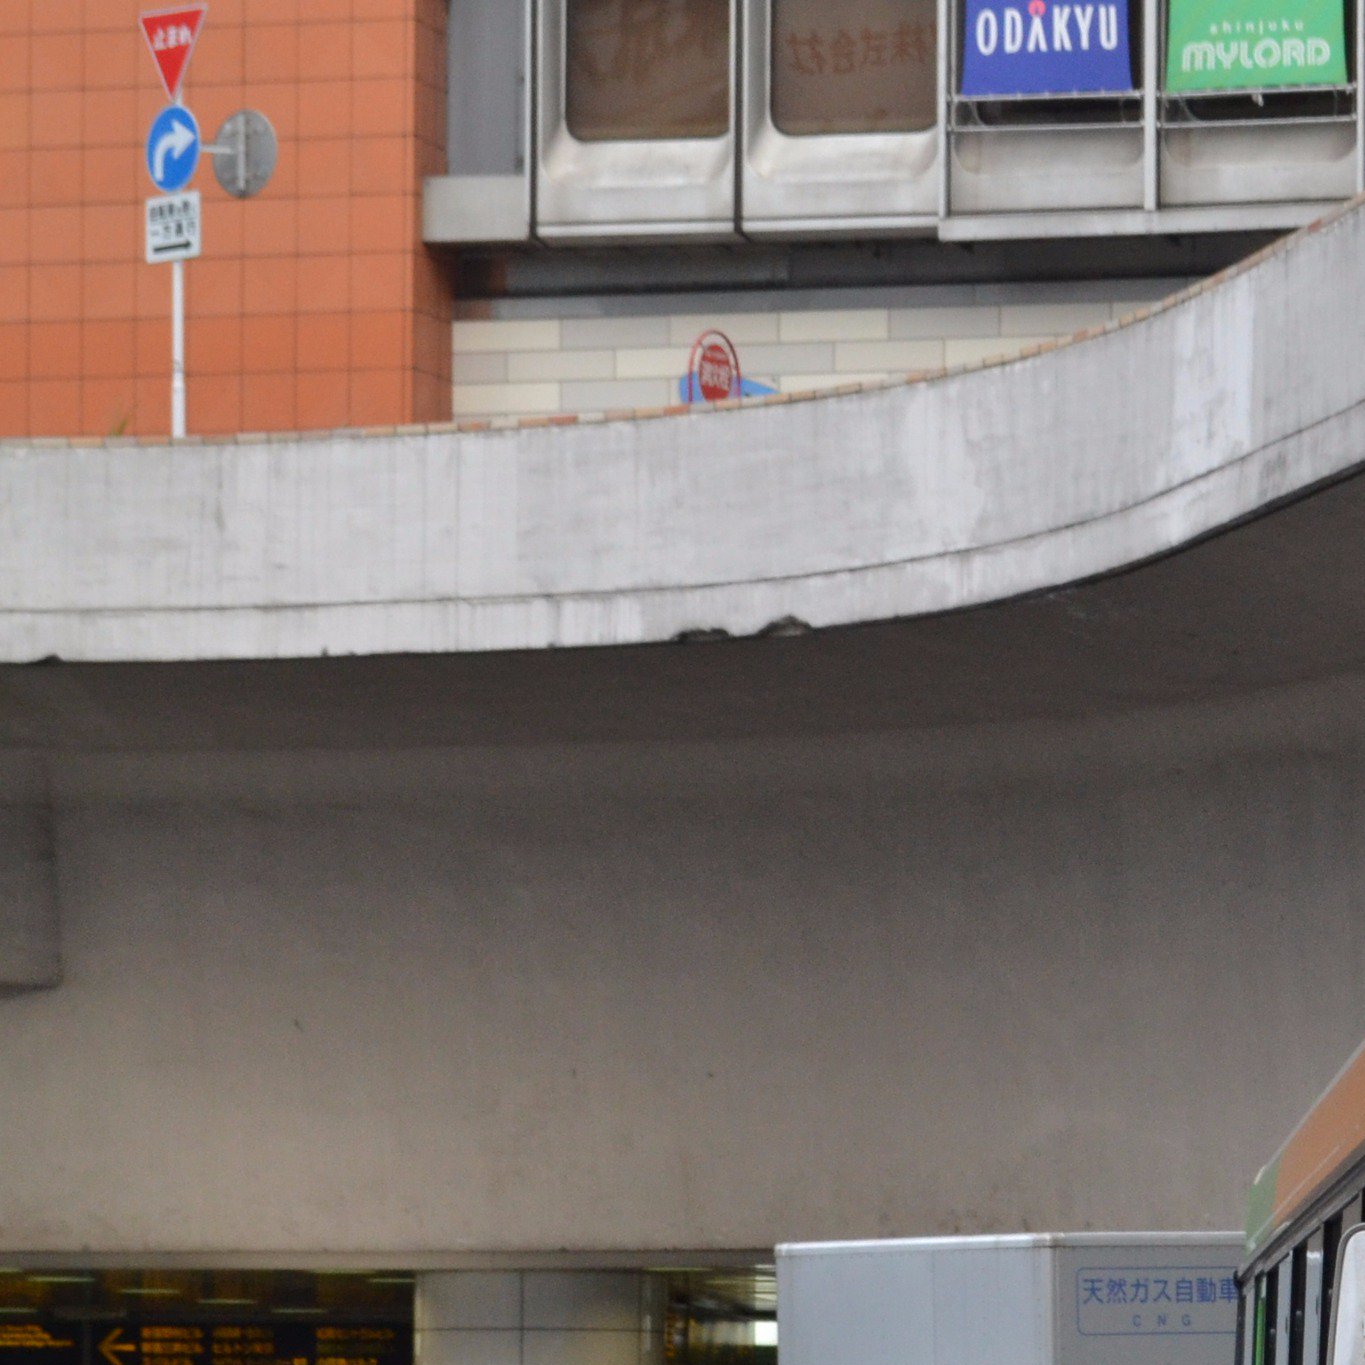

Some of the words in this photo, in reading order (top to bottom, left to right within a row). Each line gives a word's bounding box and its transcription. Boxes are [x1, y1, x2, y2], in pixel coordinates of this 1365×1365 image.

[976, 3, 1118, 56] ODAKYU
[1182, 36, 1331, 72] MYLORD
[1082, 1277, 1238, 1304] 天然ガス自動車
